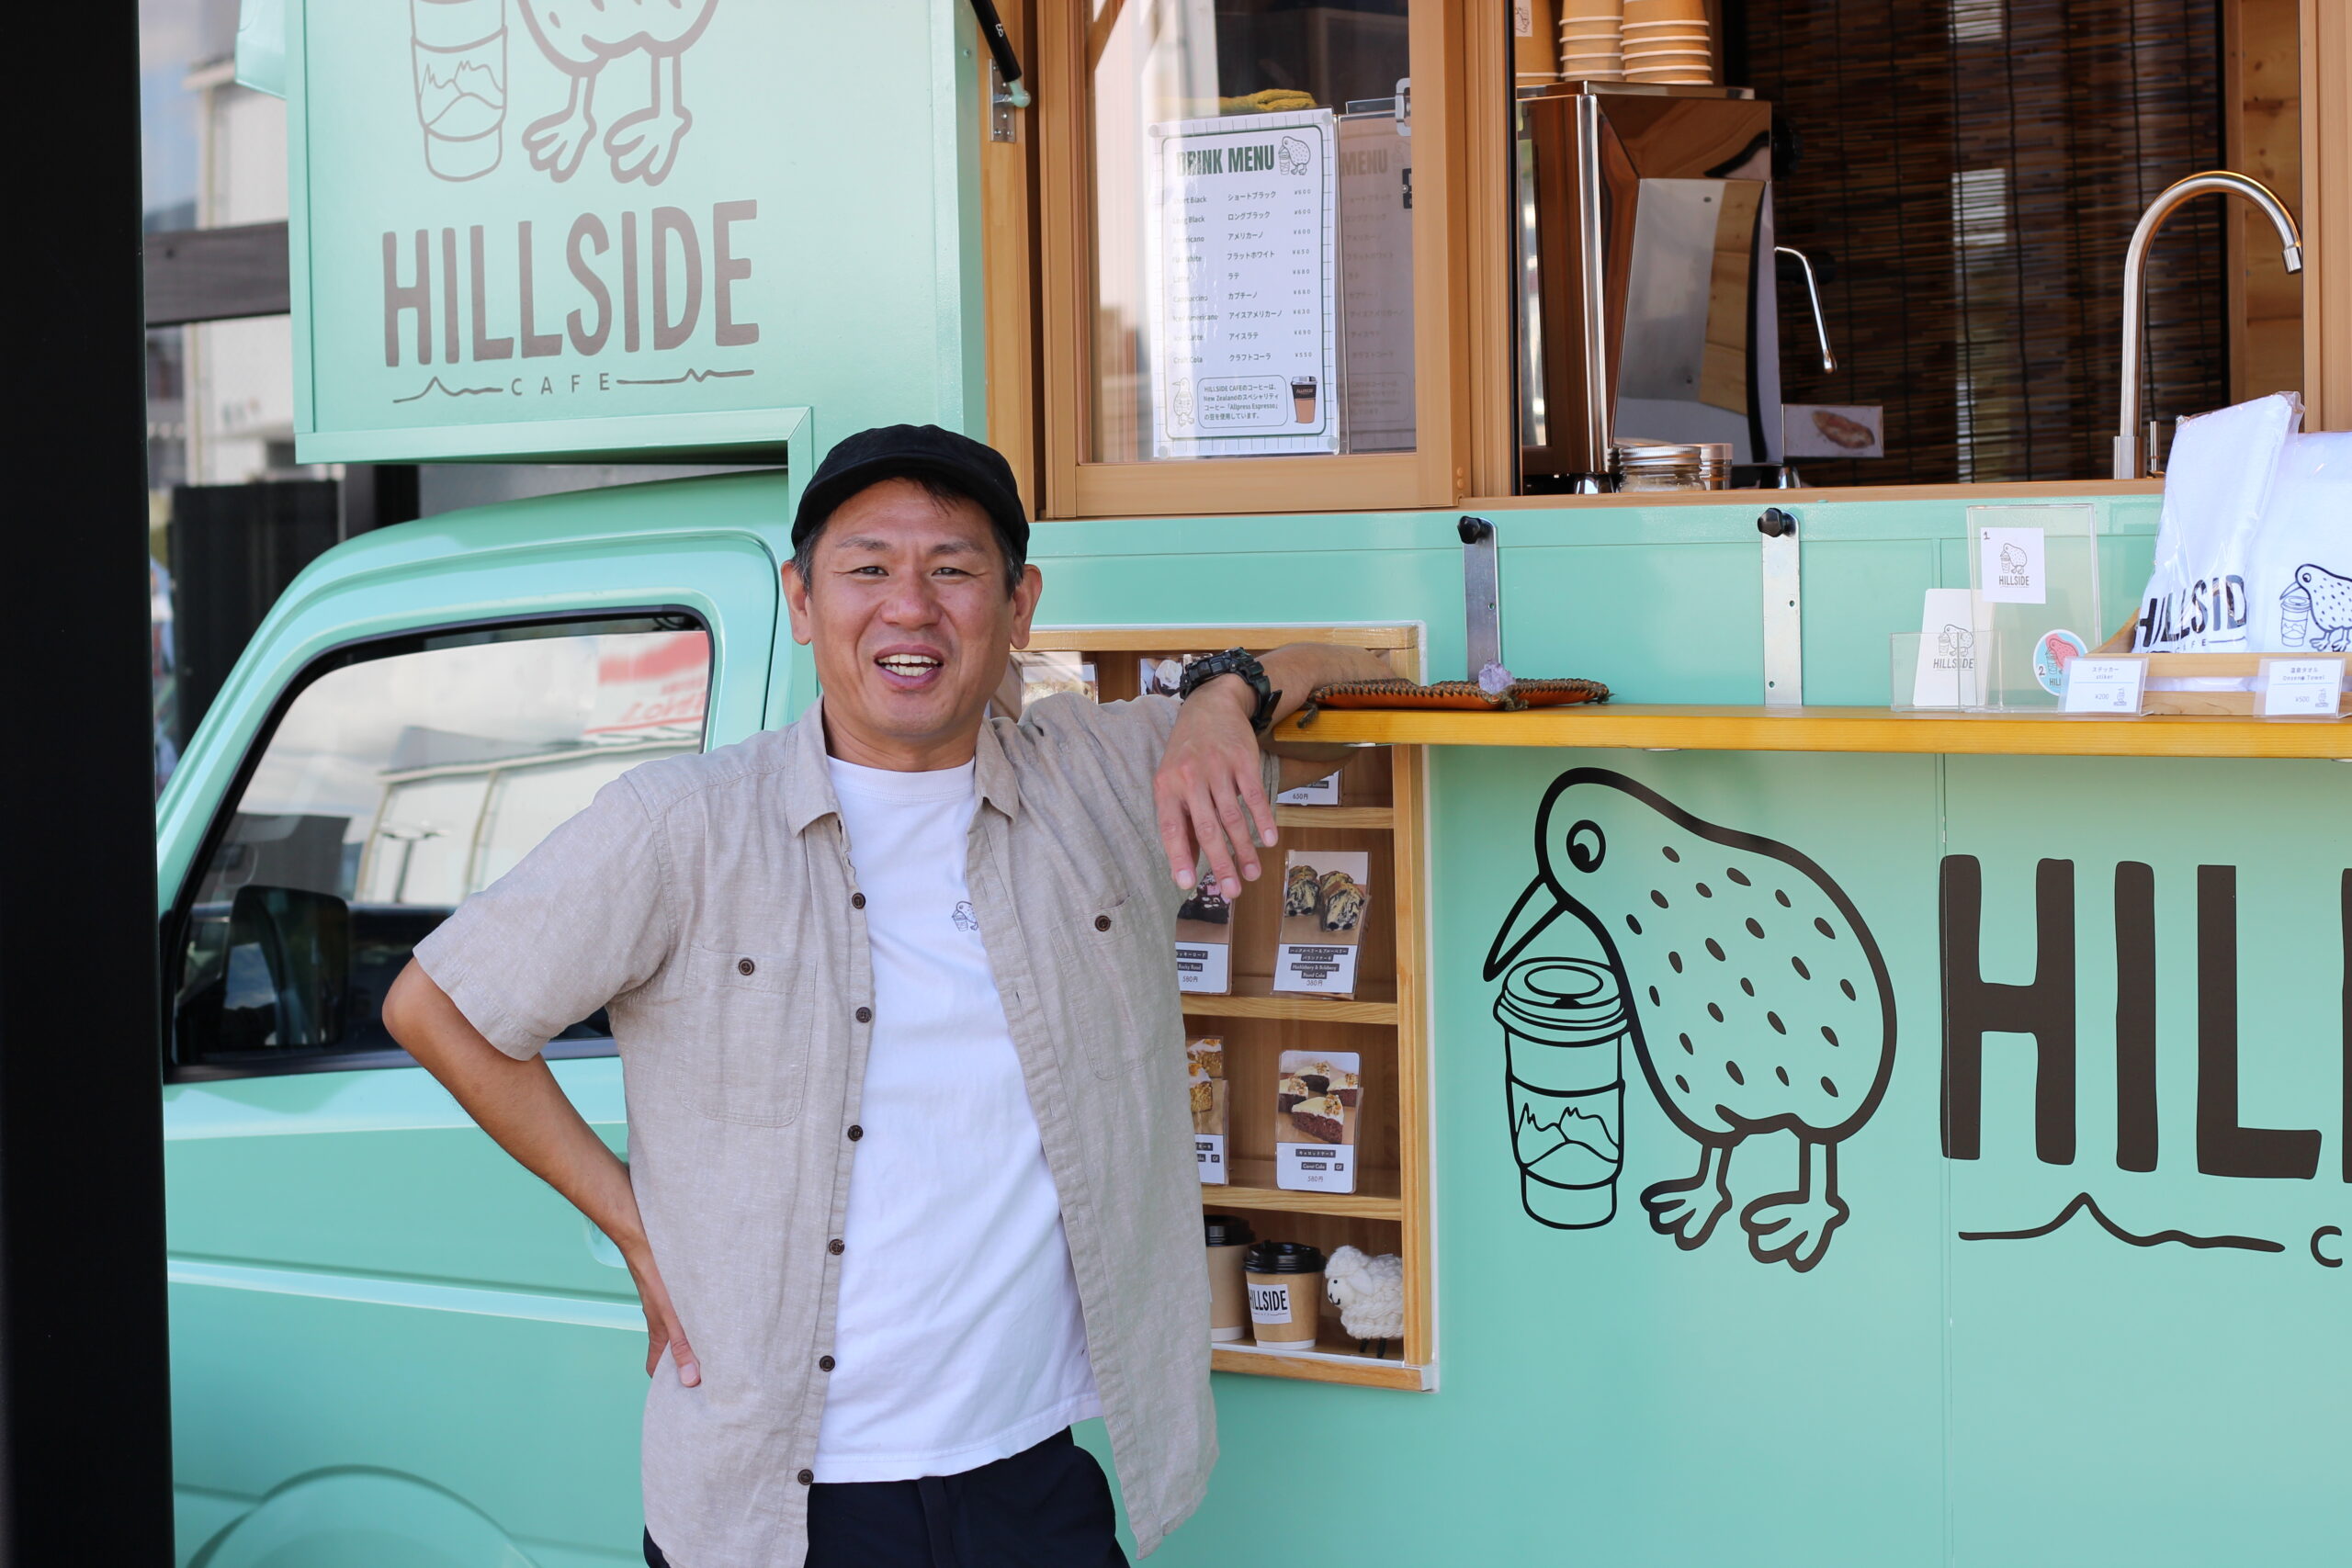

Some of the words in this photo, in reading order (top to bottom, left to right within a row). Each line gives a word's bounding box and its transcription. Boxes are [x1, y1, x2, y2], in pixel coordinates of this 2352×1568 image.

[1177, 149, 1223, 176] DRINK
[1227, 144, 1274, 173] MENU
[1190, 196, 1206, 204] Black
[1227, 191, 1276, 201] ショートブラック
[1227, 211, 1271, 220] ロングブラック
[1227, 231, 1263, 241] アメリカーノ
[1227, 250, 1275, 260] フラットホワイト
[1227, 272, 1240, 280] ラテ
[382, 199, 760, 367] HILLSIDE
[1227, 292, 1258, 300] カプチーノ
[1229, 310, 1283, 320] アイスアメリカーノ
[1229, 332, 1259, 341] アイスラテ
[1229, 353, 1272, 362] クラフトコーラ
[512, 373, 610, 396] CAFE
[1984, 531, 1991, 540] 1
[1999, 575, 2030, 586] HILLSIDE
[2039, 665, 2046, 676] 2
[1939, 854, 2352, 1183] HIL
[2311, 1225, 2343, 1268] C
